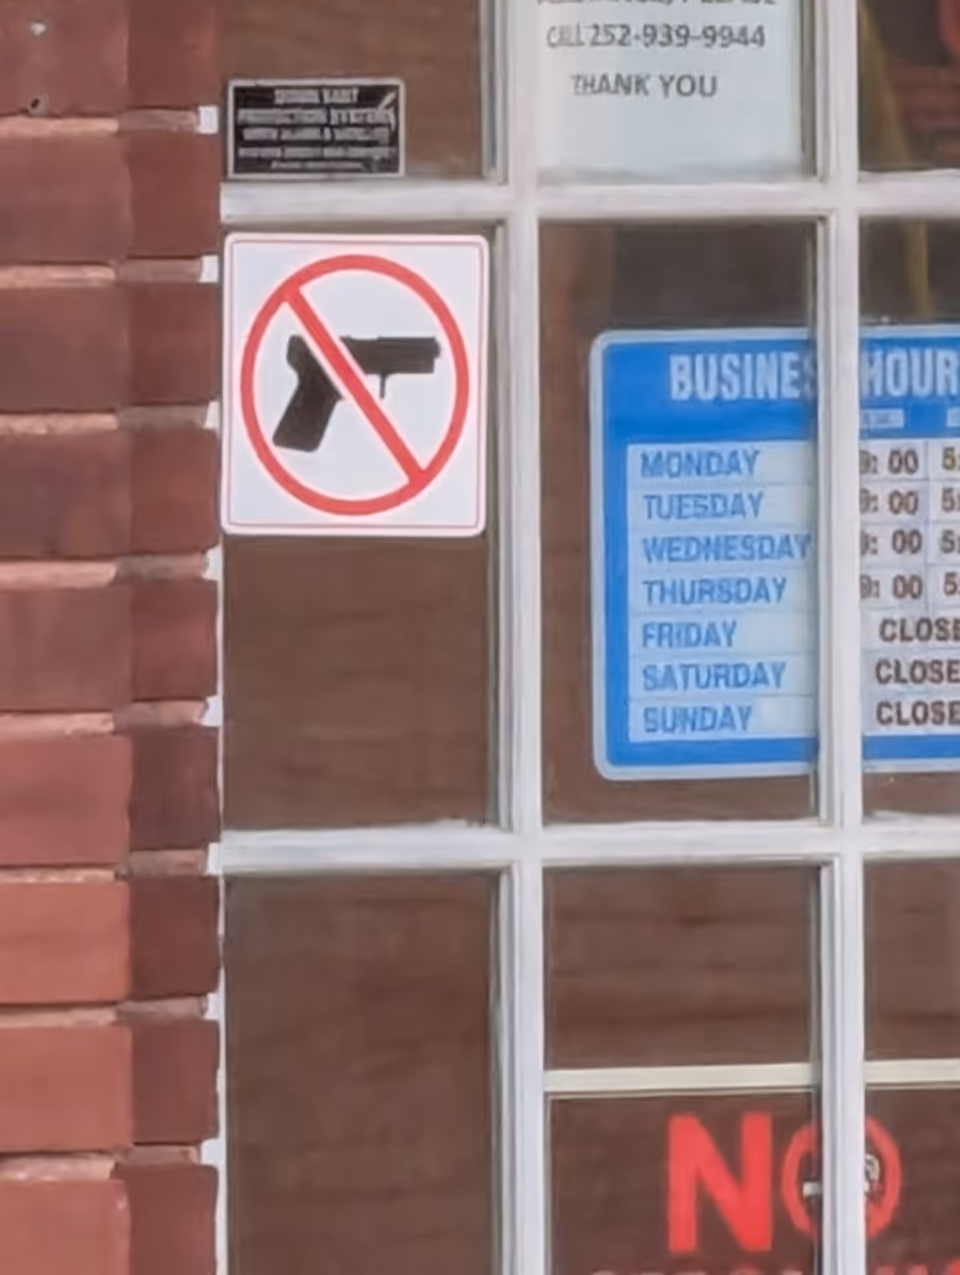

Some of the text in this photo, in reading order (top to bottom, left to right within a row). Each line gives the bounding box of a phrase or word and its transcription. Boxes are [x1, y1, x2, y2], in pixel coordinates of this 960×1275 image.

[547, 23, 766, 48] CALL 252-939-9944
[571, 74, 718, 98] THANK YOU
[640, 450, 760, 479] MONDAY
[643, 492, 764, 520] TUESDAY
[642, 534, 811, 563] WEDNESDAY
[642, 577, 787, 605] THURSDAY
[642, 620, 737, 649] FRIDAY
[642, 662, 787, 692] SATURDAY
[643, 705, 752, 734] SUNDAY
